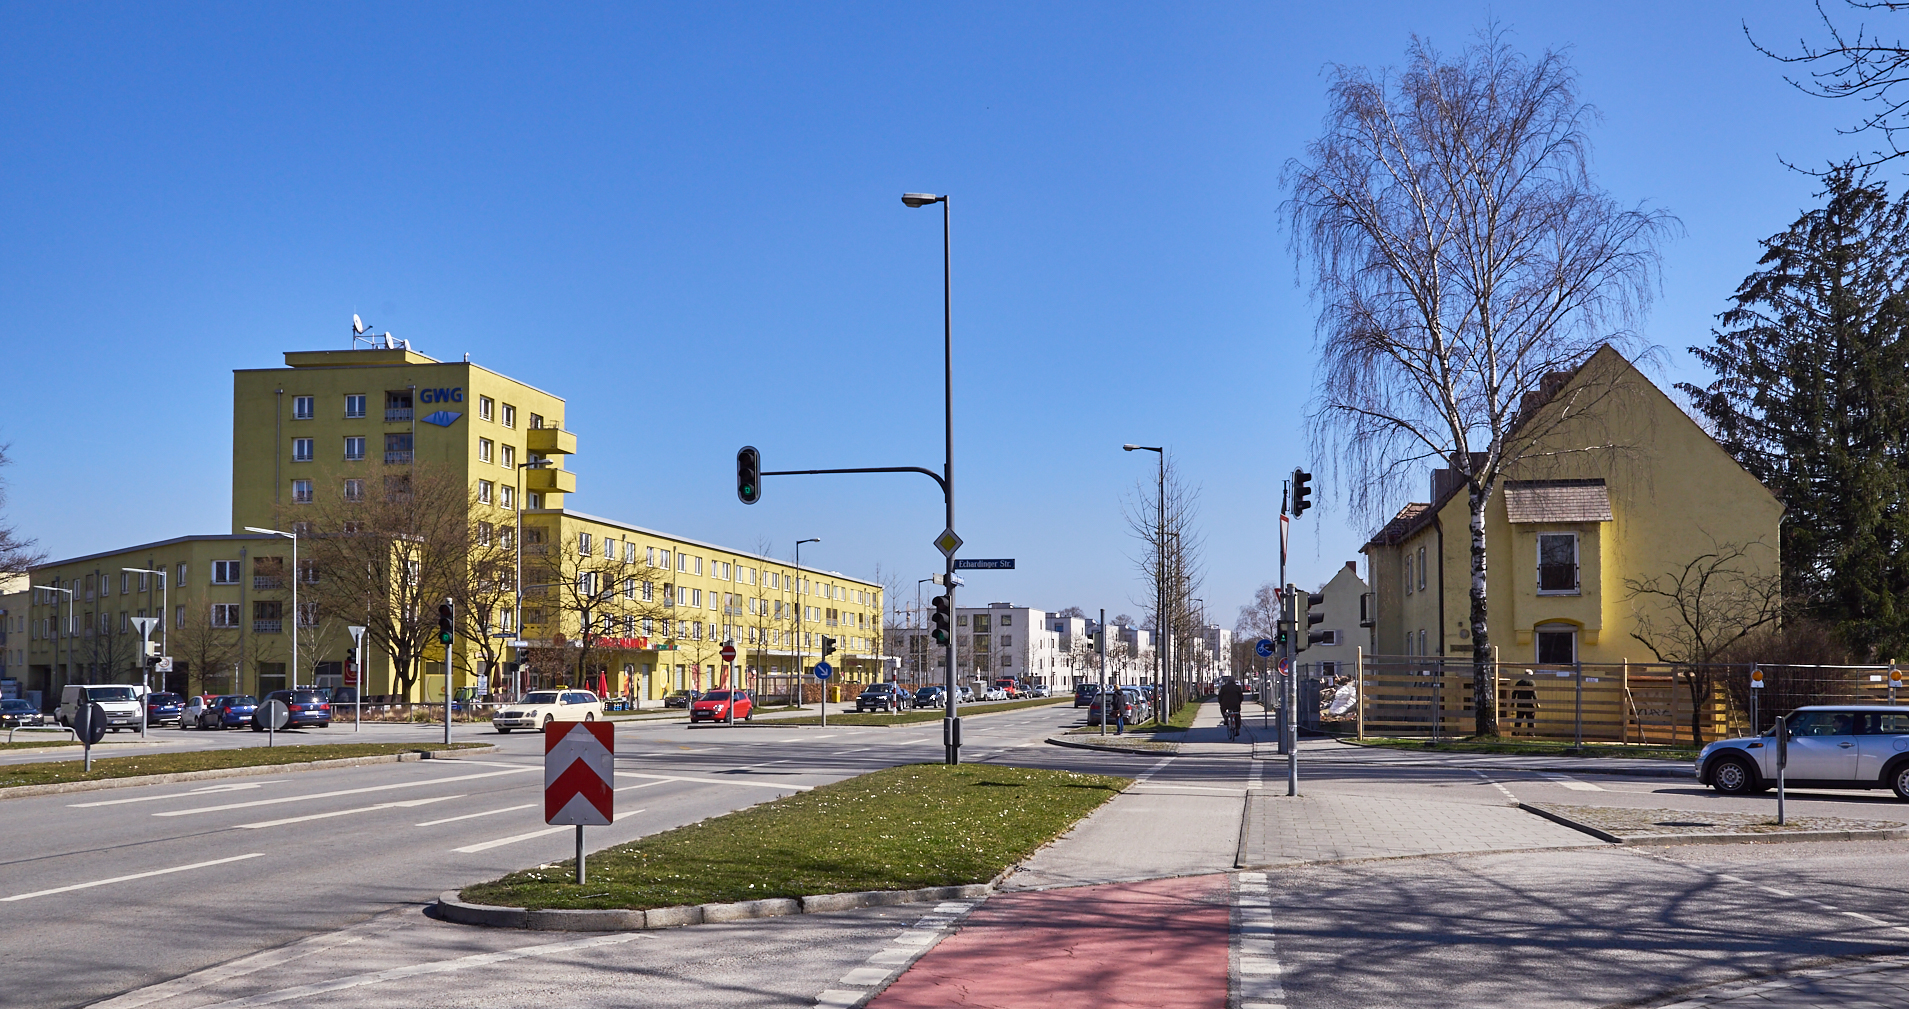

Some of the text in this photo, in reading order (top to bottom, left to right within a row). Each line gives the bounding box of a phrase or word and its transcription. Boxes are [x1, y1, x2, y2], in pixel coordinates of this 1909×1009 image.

[420, 387, 463, 404] GWG
[958, 560, 1012, 569] Echardinger Str.
